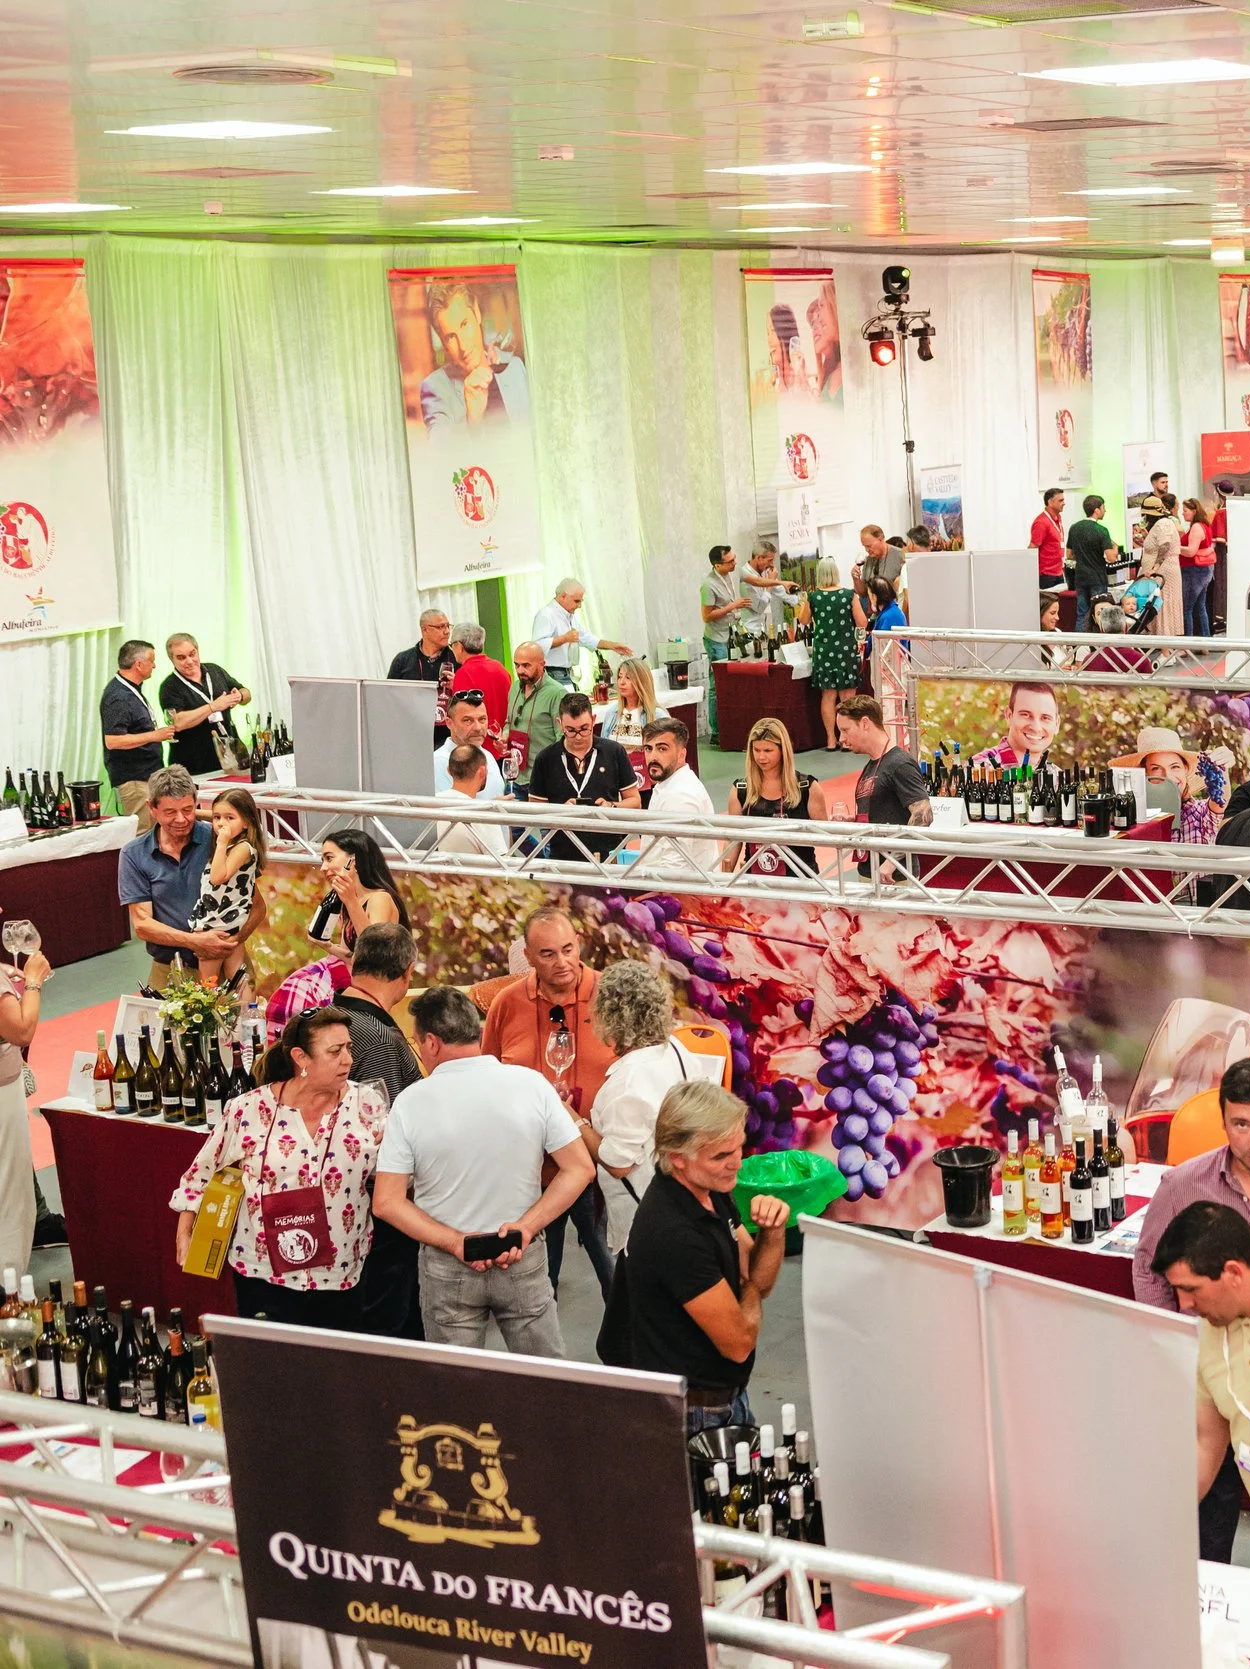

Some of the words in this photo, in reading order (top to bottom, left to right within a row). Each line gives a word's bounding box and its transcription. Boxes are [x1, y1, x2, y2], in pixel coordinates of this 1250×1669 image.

[463, 561, 492, 573] Albufeira
[1, 617, 43, 632] Albufeira
[268, 1531, 426, 1592] QUINTA
[431, 1569, 478, 1600] DO
[485, 1574, 673, 1633] FRANCÊS
[347, 1600, 451, 1637] Odelouca
[456, 1618, 517, 1650] River
[519, 1629, 593, 1665] Valley
